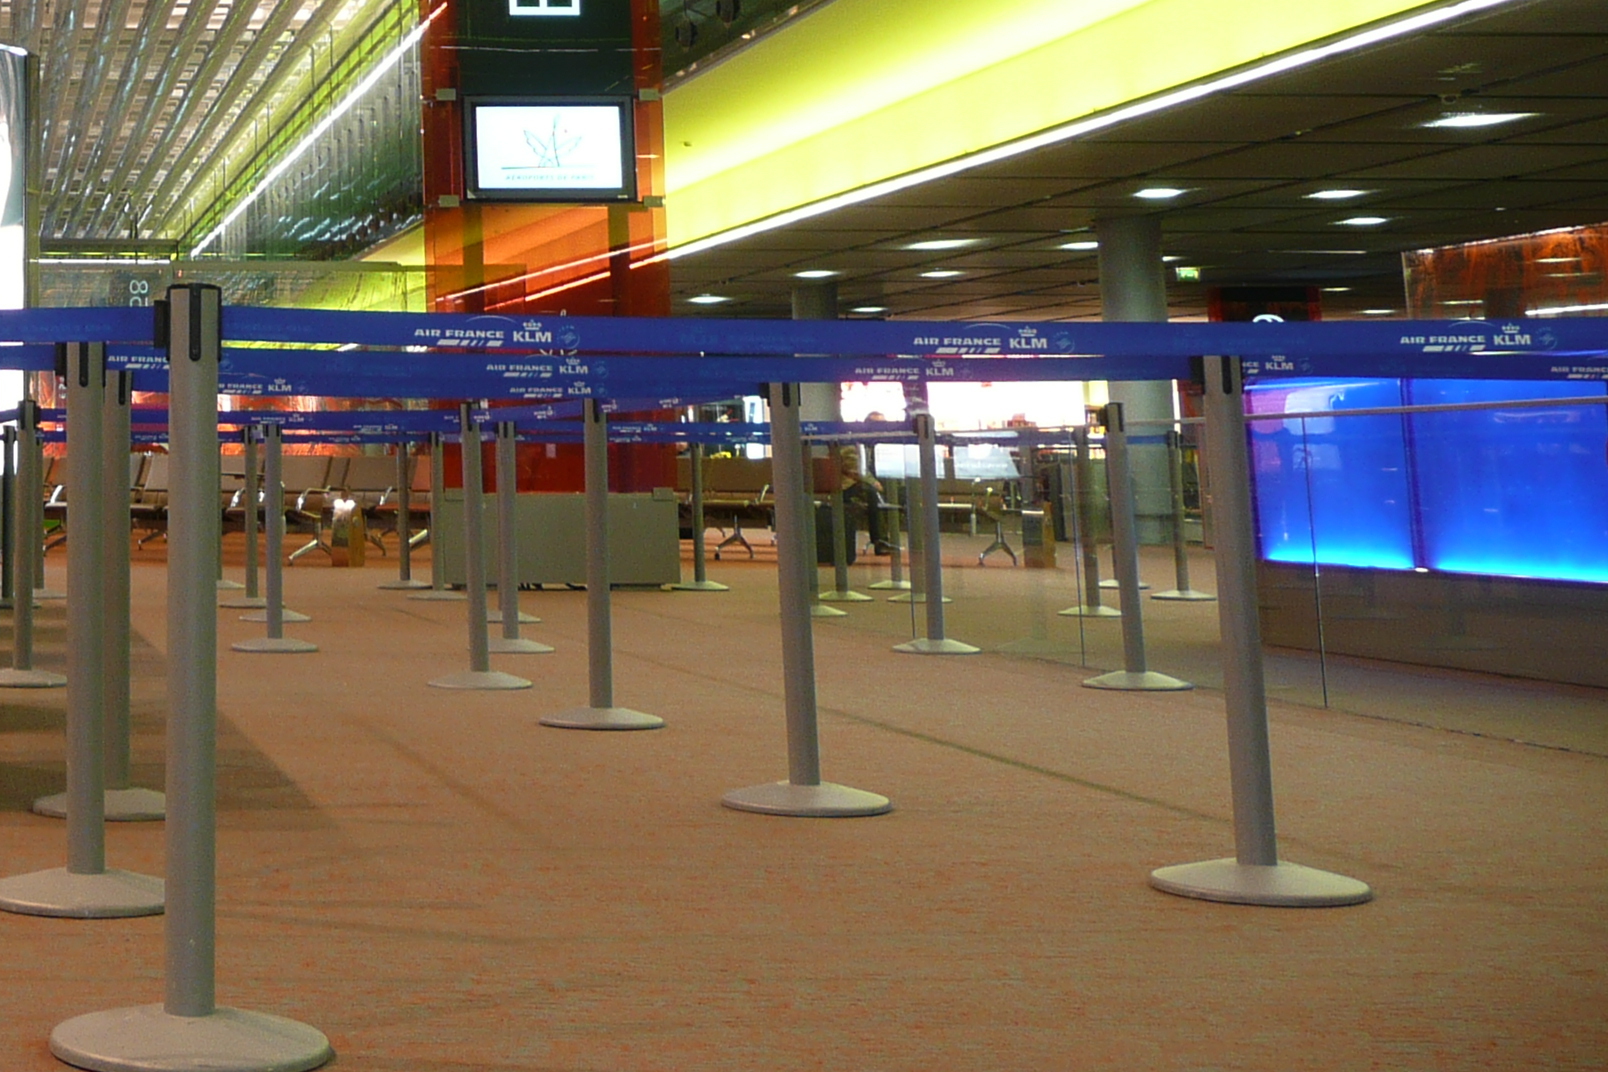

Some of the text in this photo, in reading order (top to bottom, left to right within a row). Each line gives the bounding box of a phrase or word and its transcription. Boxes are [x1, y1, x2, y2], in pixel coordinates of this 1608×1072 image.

[413, 328, 553, 343] AIR FRANCE KLM
[1400, 334, 1532, 345] AIR FRANCE KLM
[912, 336, 1048, 350] AIR FRANCE KLM
[107, 355, 169, 364] AIR FRANC
[485, 363, 589, 375] AIR FRANCE KLM
[1264, 361, 1294, 371] KLM
[854, 367, 955, 377] AIR FRANCE KLM
[267, 383, 292, 392] KLM
[567, 386, 592, 395] KLM
